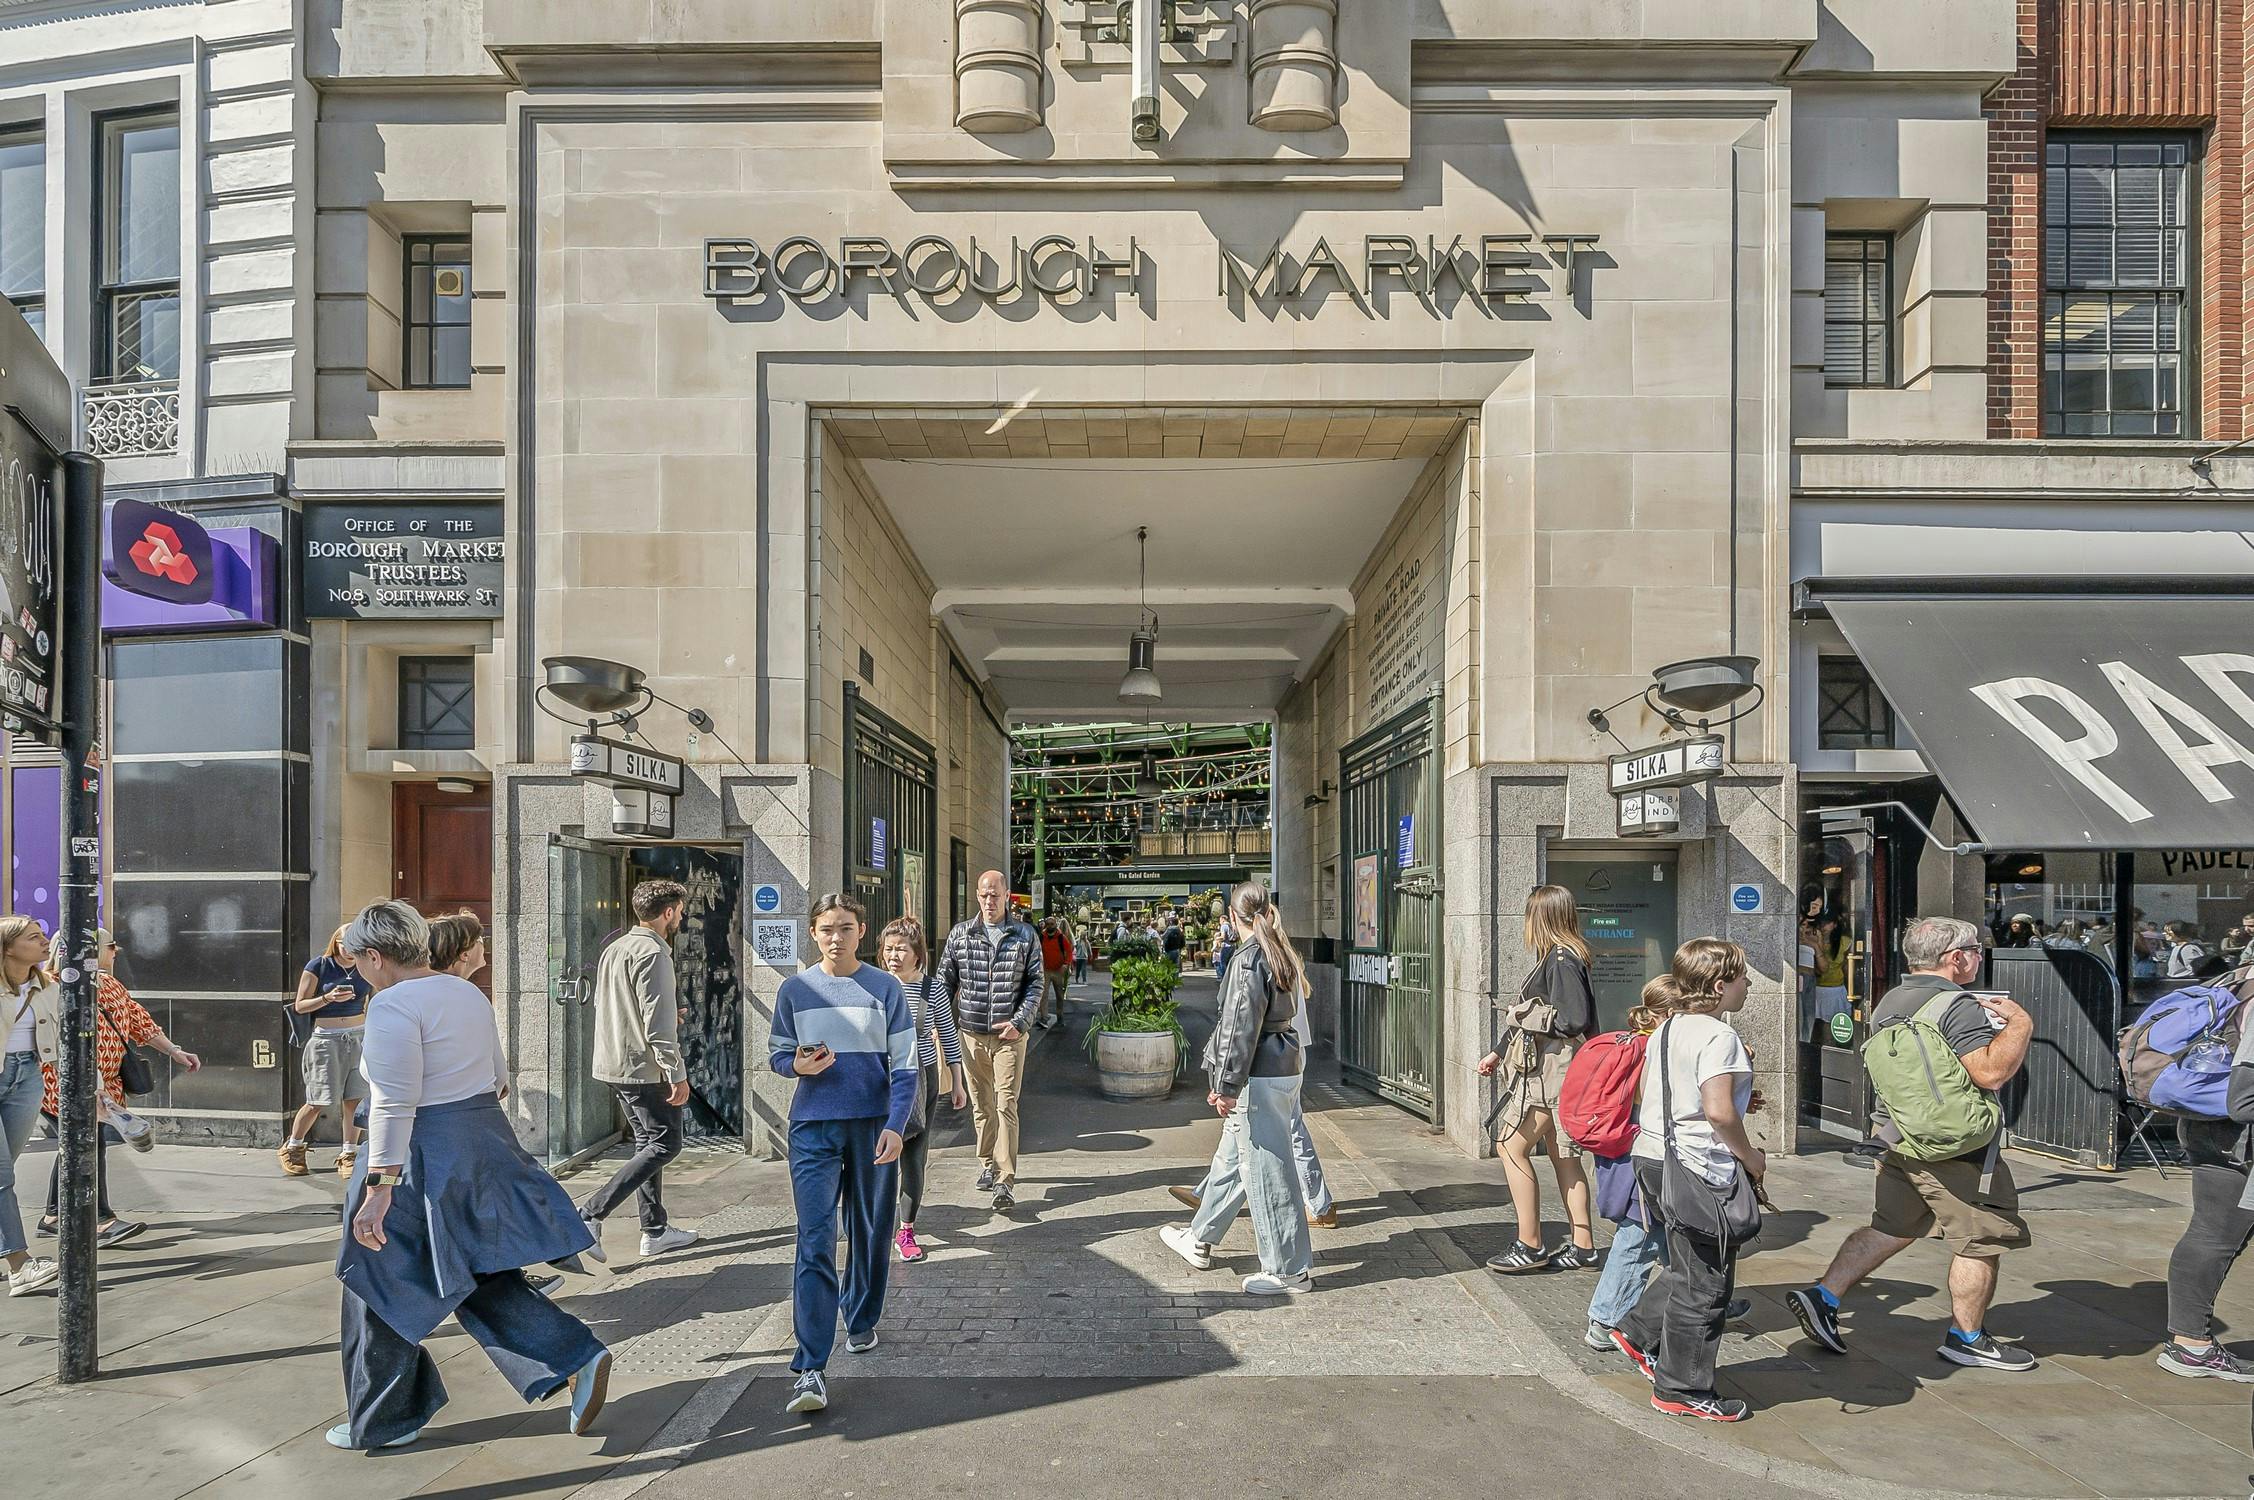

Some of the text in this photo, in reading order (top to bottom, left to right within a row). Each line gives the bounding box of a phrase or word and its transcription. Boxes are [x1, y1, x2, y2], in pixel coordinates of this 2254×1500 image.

[703, 233, 1601, 298] BOROUGH MARKET
[344, 518, 474, 532] OFFICE OF THE
[308, 540, 403, 558] BOROUGH
[364, 562, 462, 580] TRUSTEES
[1400, 558, 1420, 595] ROAD
[375, 588, 467, 602] SOUTHWARK
[1402, 590, 1427, 622] TRUSTEES
[1406, 611, 1425, 637] EXCEPT
[1396, 632, 1419, 662] BUSINESS
[1370, 646, 1423, 710] ENTRANCE ONLY
[627, 753, 667, 782] SILKA
[1626, 753, 1667, 781] SILKA
[2161, 851, 2254, 876] PADEL
